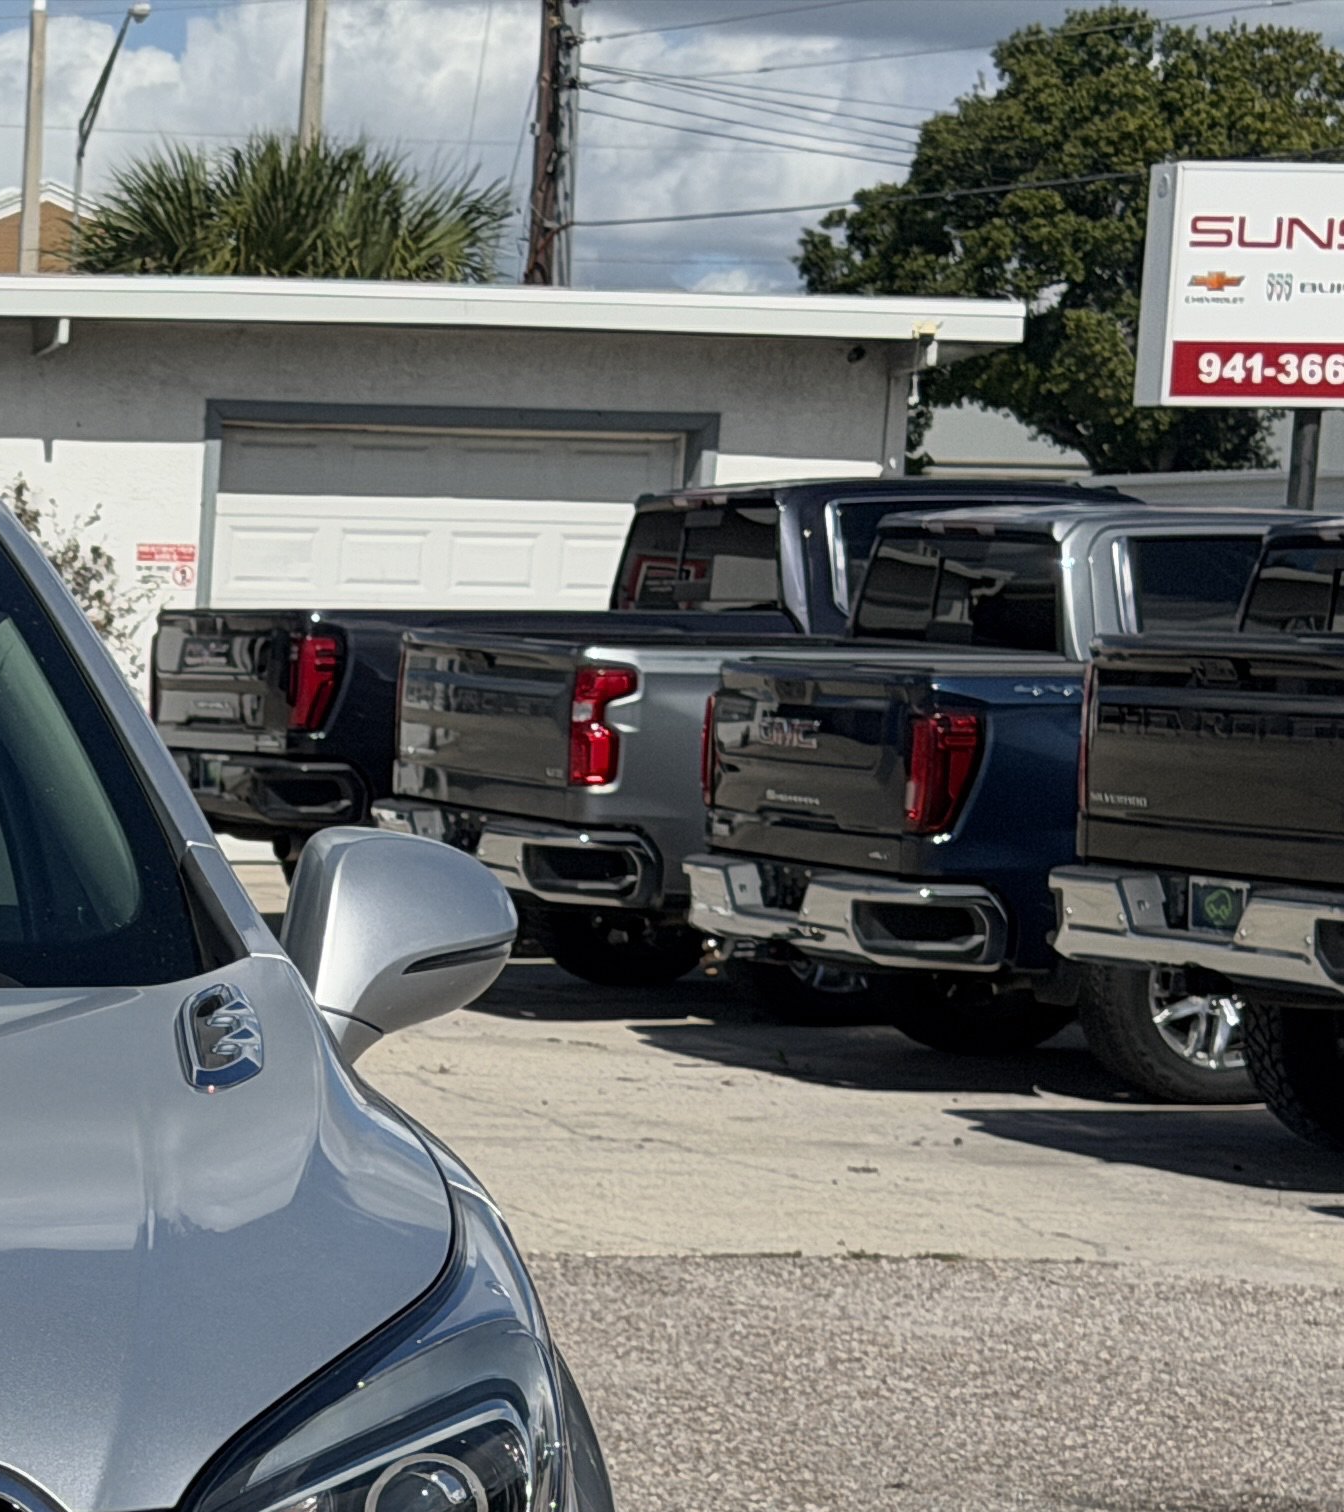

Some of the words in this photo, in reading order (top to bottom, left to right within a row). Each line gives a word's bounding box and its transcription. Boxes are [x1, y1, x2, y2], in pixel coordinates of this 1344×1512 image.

[1189, 215, 1344, 250] SUN
[1299, 282, 1344, 294] BUI
[1198, 352, 1344, 385] 941-366
[760, 716, 821, 749] GMC
